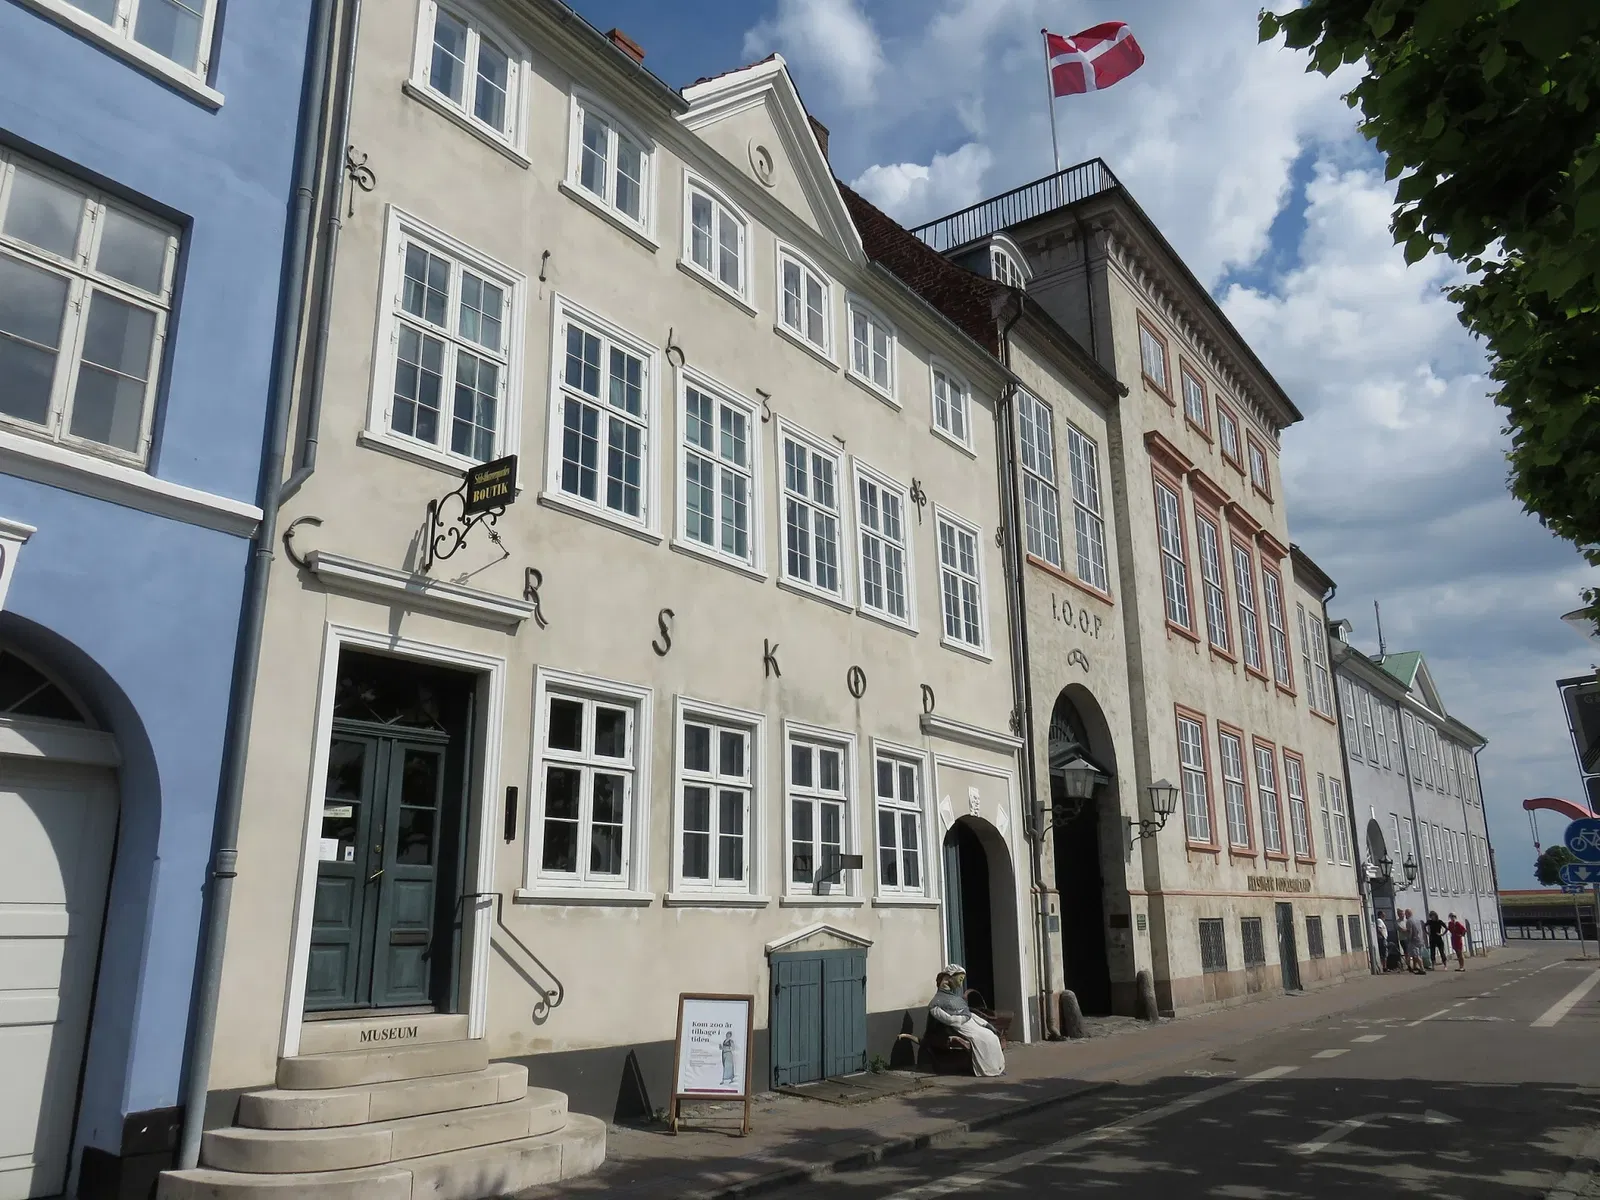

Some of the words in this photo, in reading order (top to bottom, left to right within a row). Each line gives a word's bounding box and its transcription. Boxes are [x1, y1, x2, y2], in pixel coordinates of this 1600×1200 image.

[473, 481, 508, 503] BOUTIK
[360, 1026, 418, 1043] MUSEUM
[691, 1028, 717, 1036] tilbage
